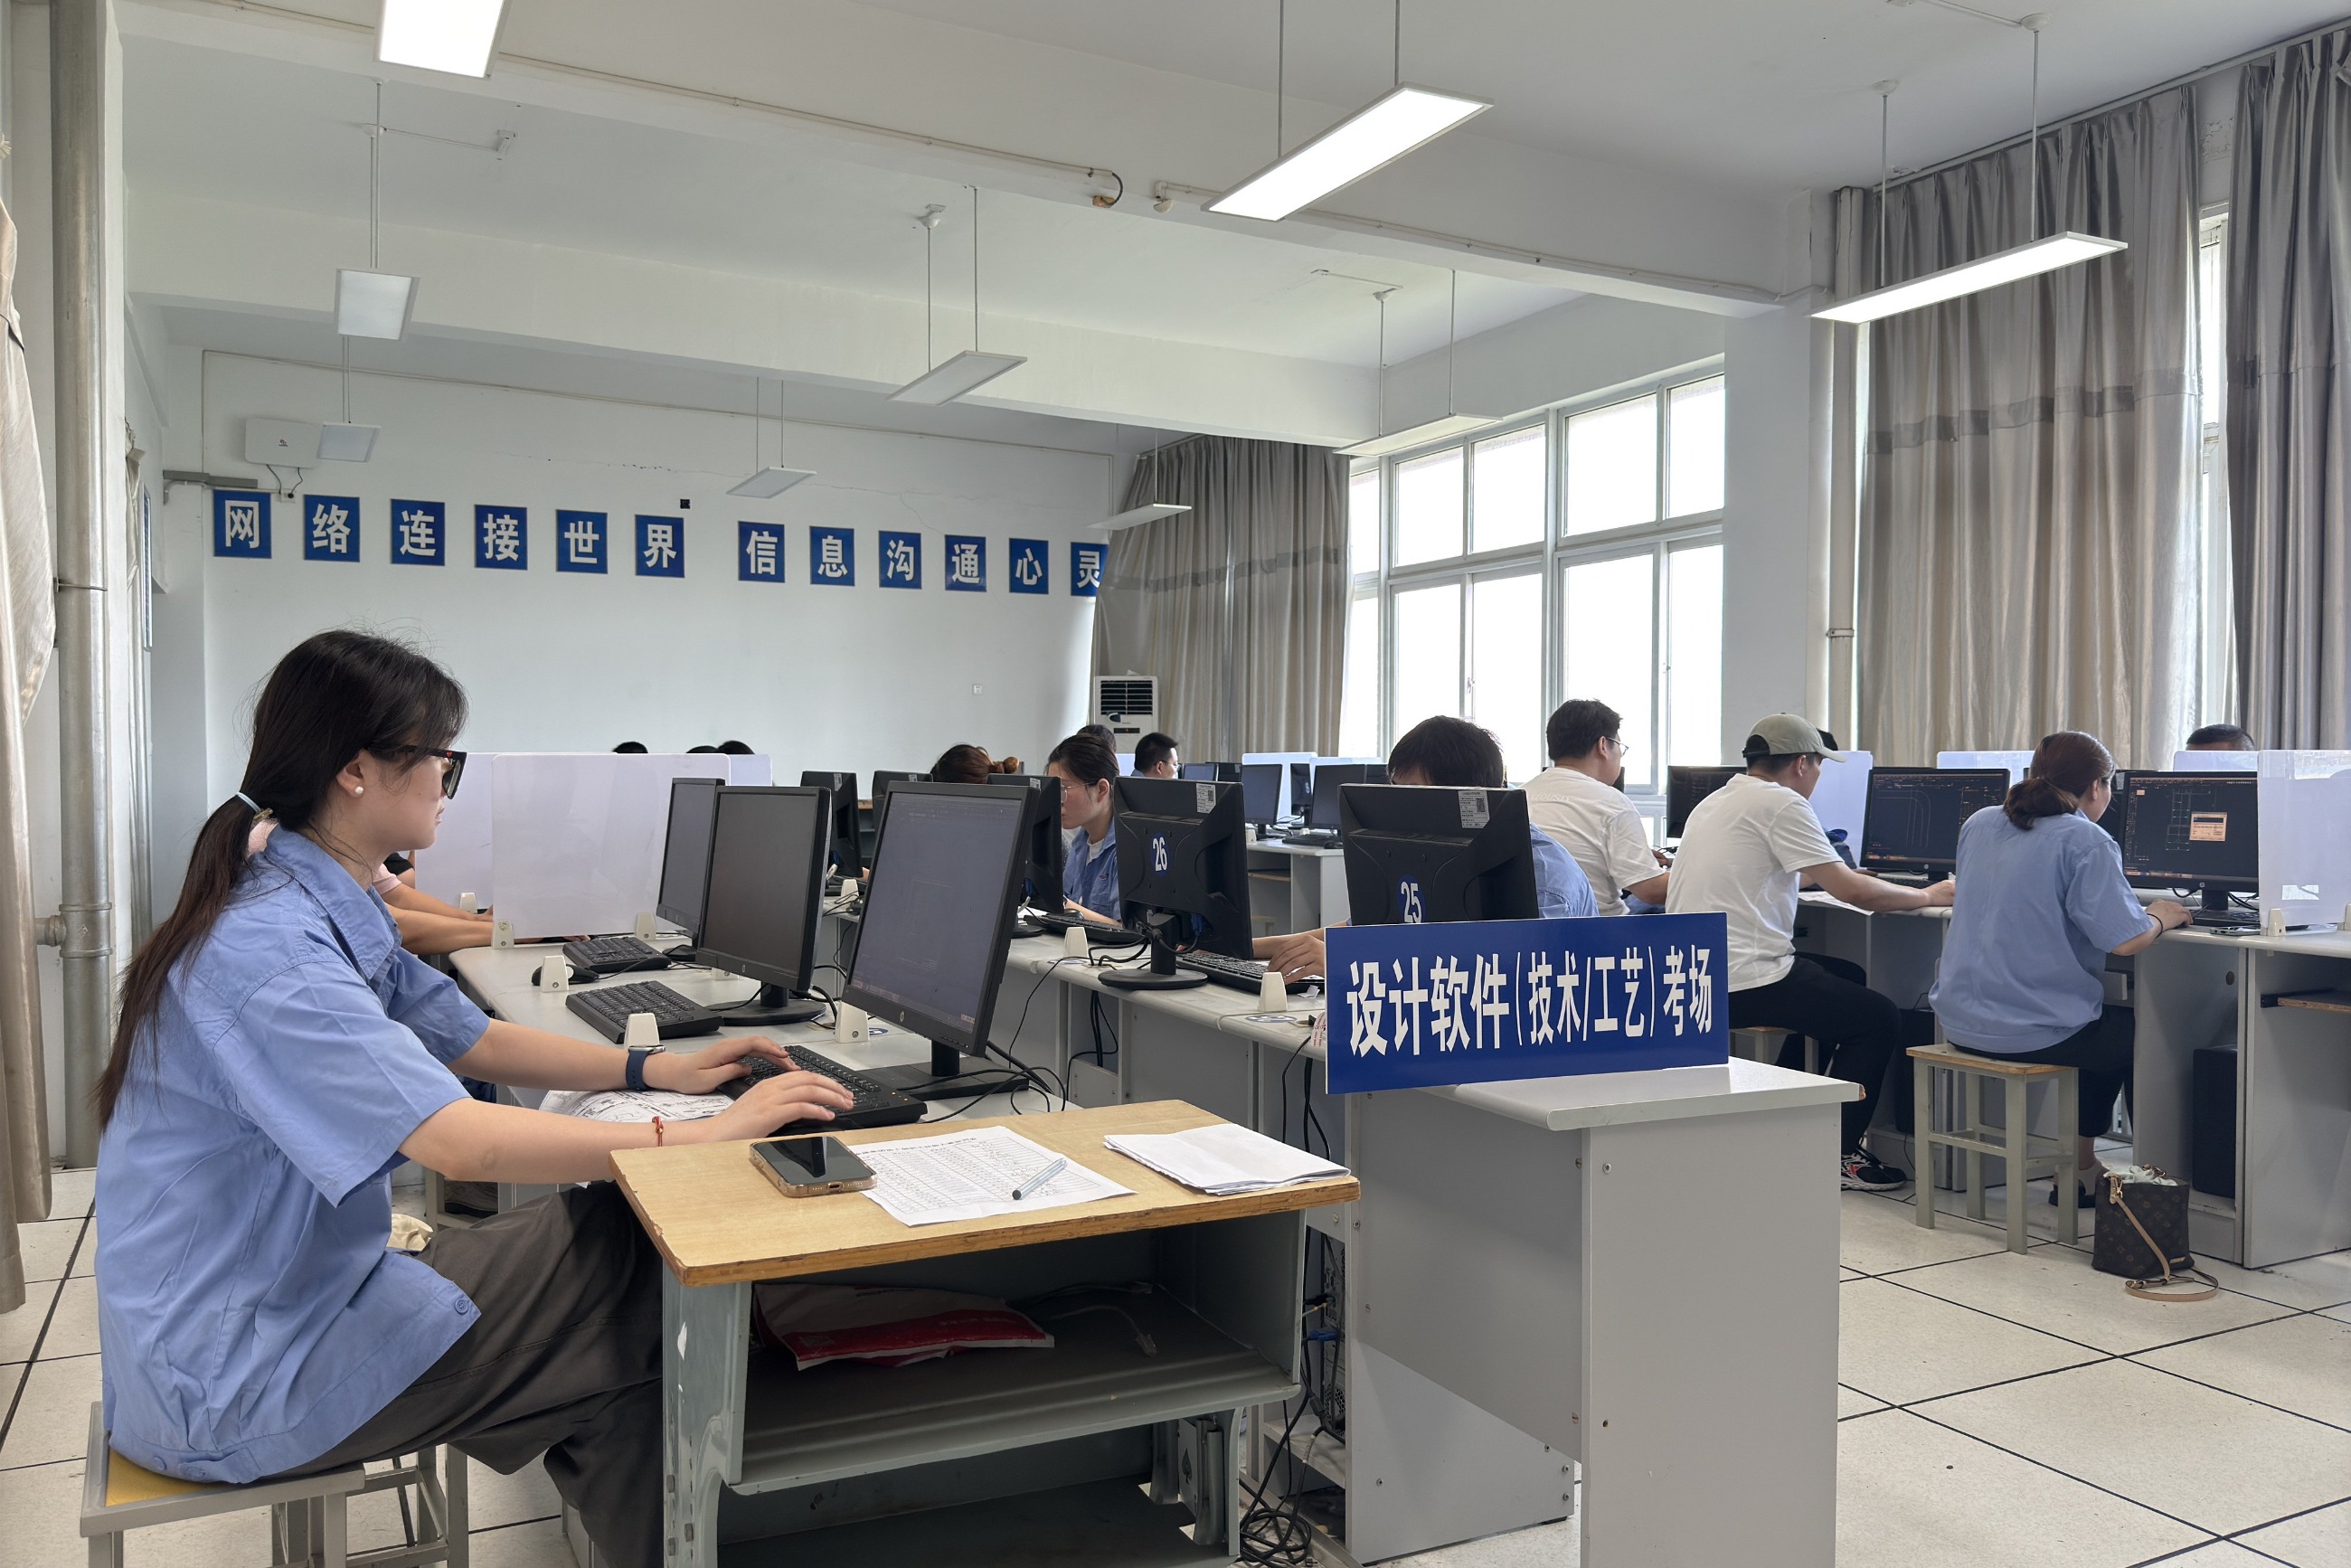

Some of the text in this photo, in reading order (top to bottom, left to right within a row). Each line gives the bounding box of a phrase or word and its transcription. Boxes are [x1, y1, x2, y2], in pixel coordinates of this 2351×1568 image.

[225, 500, 1100, 589] 网络连接世界 信息沟通心灵
[1153, 836, 1167, 872] 26
[1401, 882, 1422, 923] 25
[1347, 945, 1712, 1058] 设计软件(技术/工艺)考场
